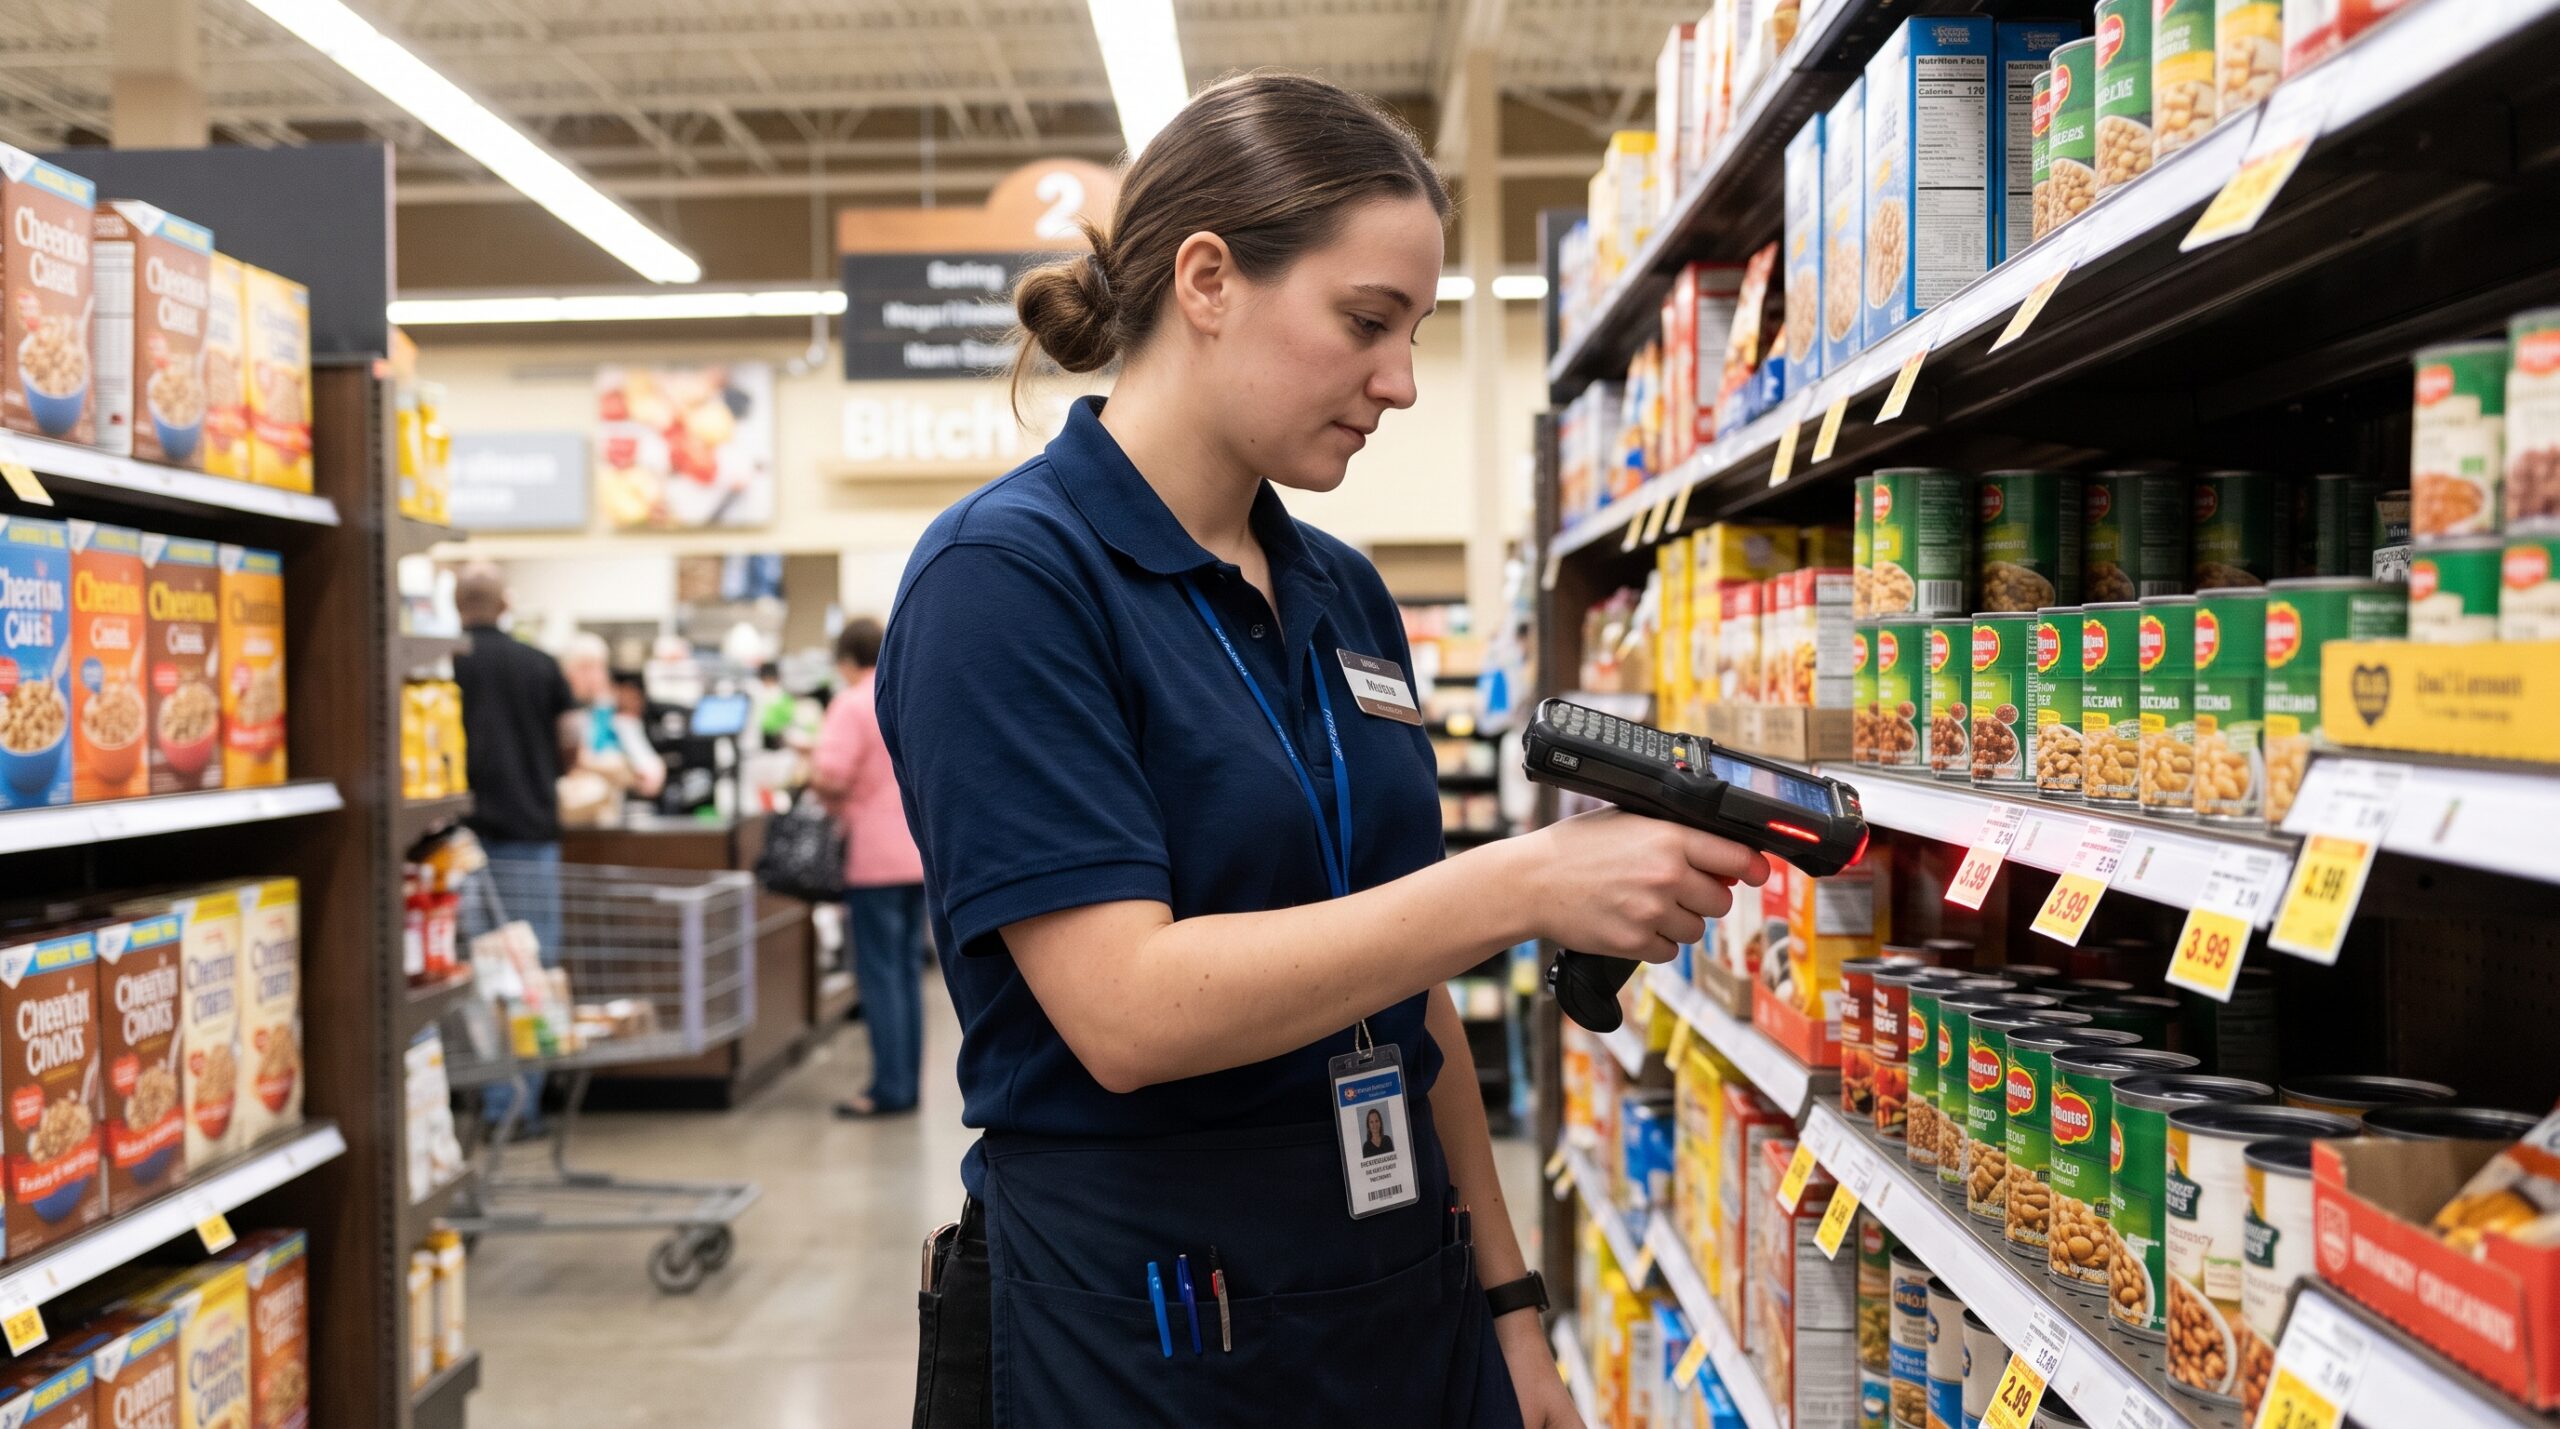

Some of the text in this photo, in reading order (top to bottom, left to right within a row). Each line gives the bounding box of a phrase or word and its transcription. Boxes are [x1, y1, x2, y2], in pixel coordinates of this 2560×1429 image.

[1035, 170, 1085, 238] 2
[1959, 860, 1991, 891] 3.99
[2048, 887, 2090, 923] 3.99
[2186, 928, 2230, 970] 3.99
[2002, 1376, 2032, 1418] 2.99
